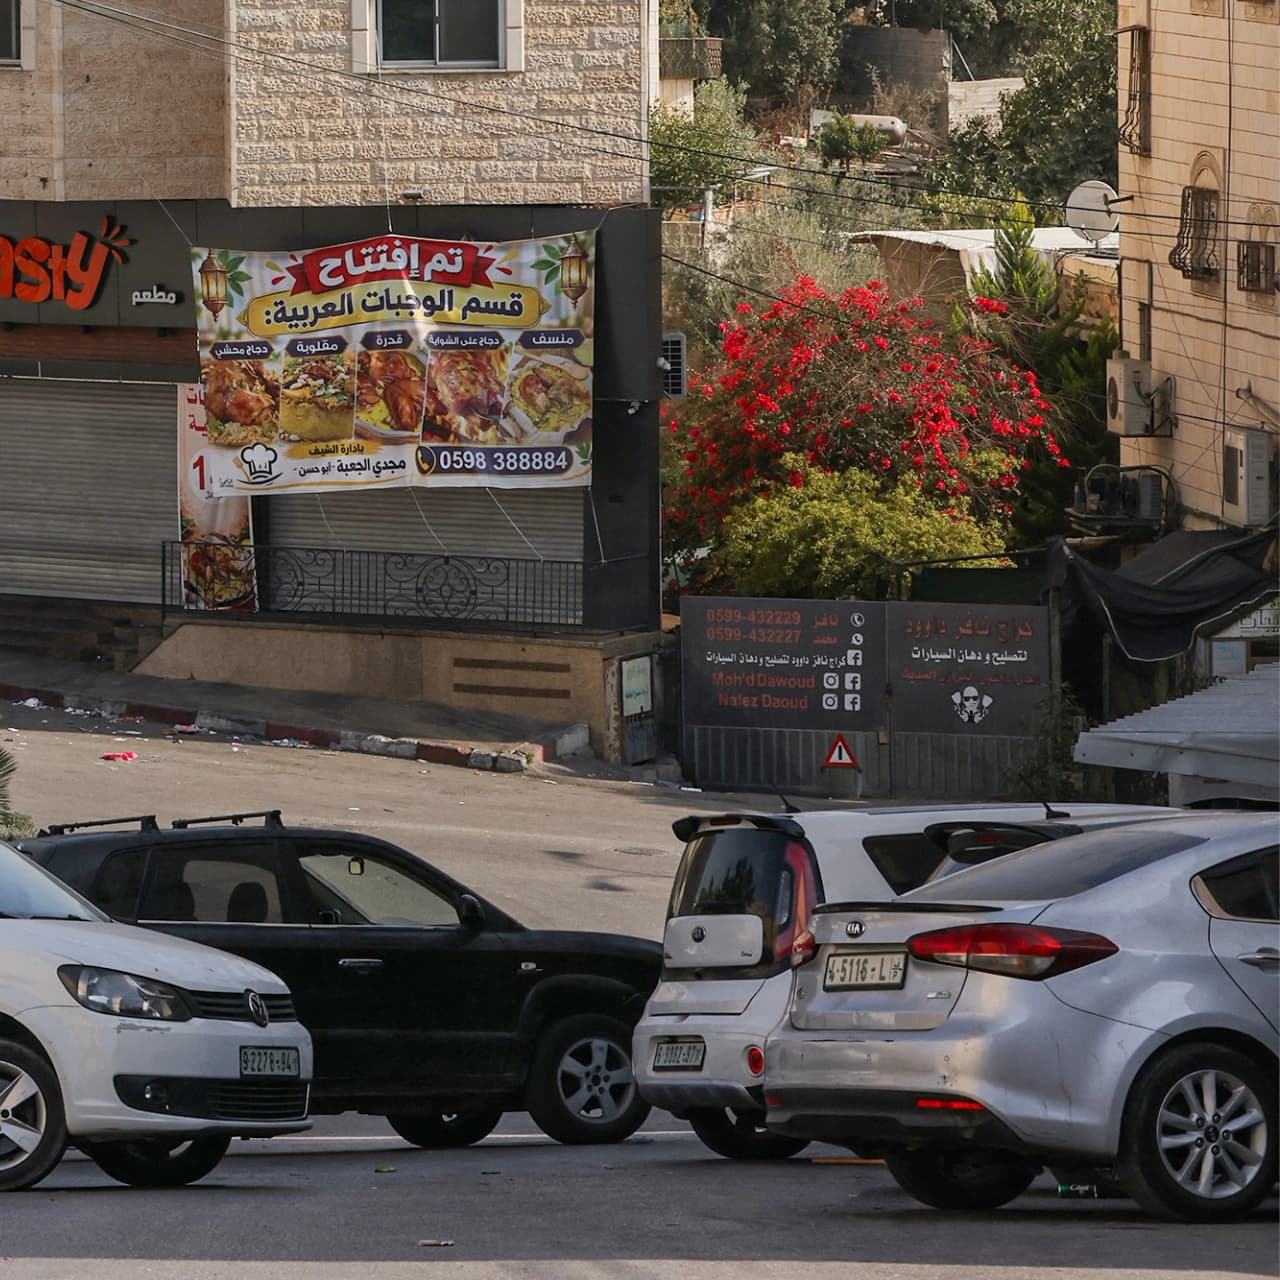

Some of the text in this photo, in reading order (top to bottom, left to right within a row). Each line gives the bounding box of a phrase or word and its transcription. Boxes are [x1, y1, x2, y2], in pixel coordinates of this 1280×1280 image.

[319, 240, 464, 287] تم إفتتاح
[132, 285, 176, 305] مطعم
[265, 288, 523, 329] قسم الوجبات العربية:
[376, 333, 404, 347] قدرة
[428, 334, 500, 346] دجاج على الشواية
[532, 333, 574, 345] منسف
[215, 344, 268, 358] دجاج محشي
[296, 340, 338, 354] مقلوبة
[308, 444, 339, 456] الشيف
[440, 450, 568, 470] 0598 388884
[336, 458, 370, 477] الجعبة
[372, 457, 406, 478] مجدي
[706, 608, 801, 625] 0599-432229
[706, 627, 801, 643] 0599-432227
[706, 651, 736, 664] السيارات
[765, 655, 789, 667] لتصليح
[813, 655, 828, 667] نافز
[912, 646, 956, 662] السيارات
[957, 649, 982, 663] دهان
[992, 650, 1028, 665] لتصليح
[829, 656, 847, 668] كراج
[757, 673, 817, 689] Dawoud
[718, 693, 808, 709] Nafez Daoud
[847, 923, 860, 934] KIA
